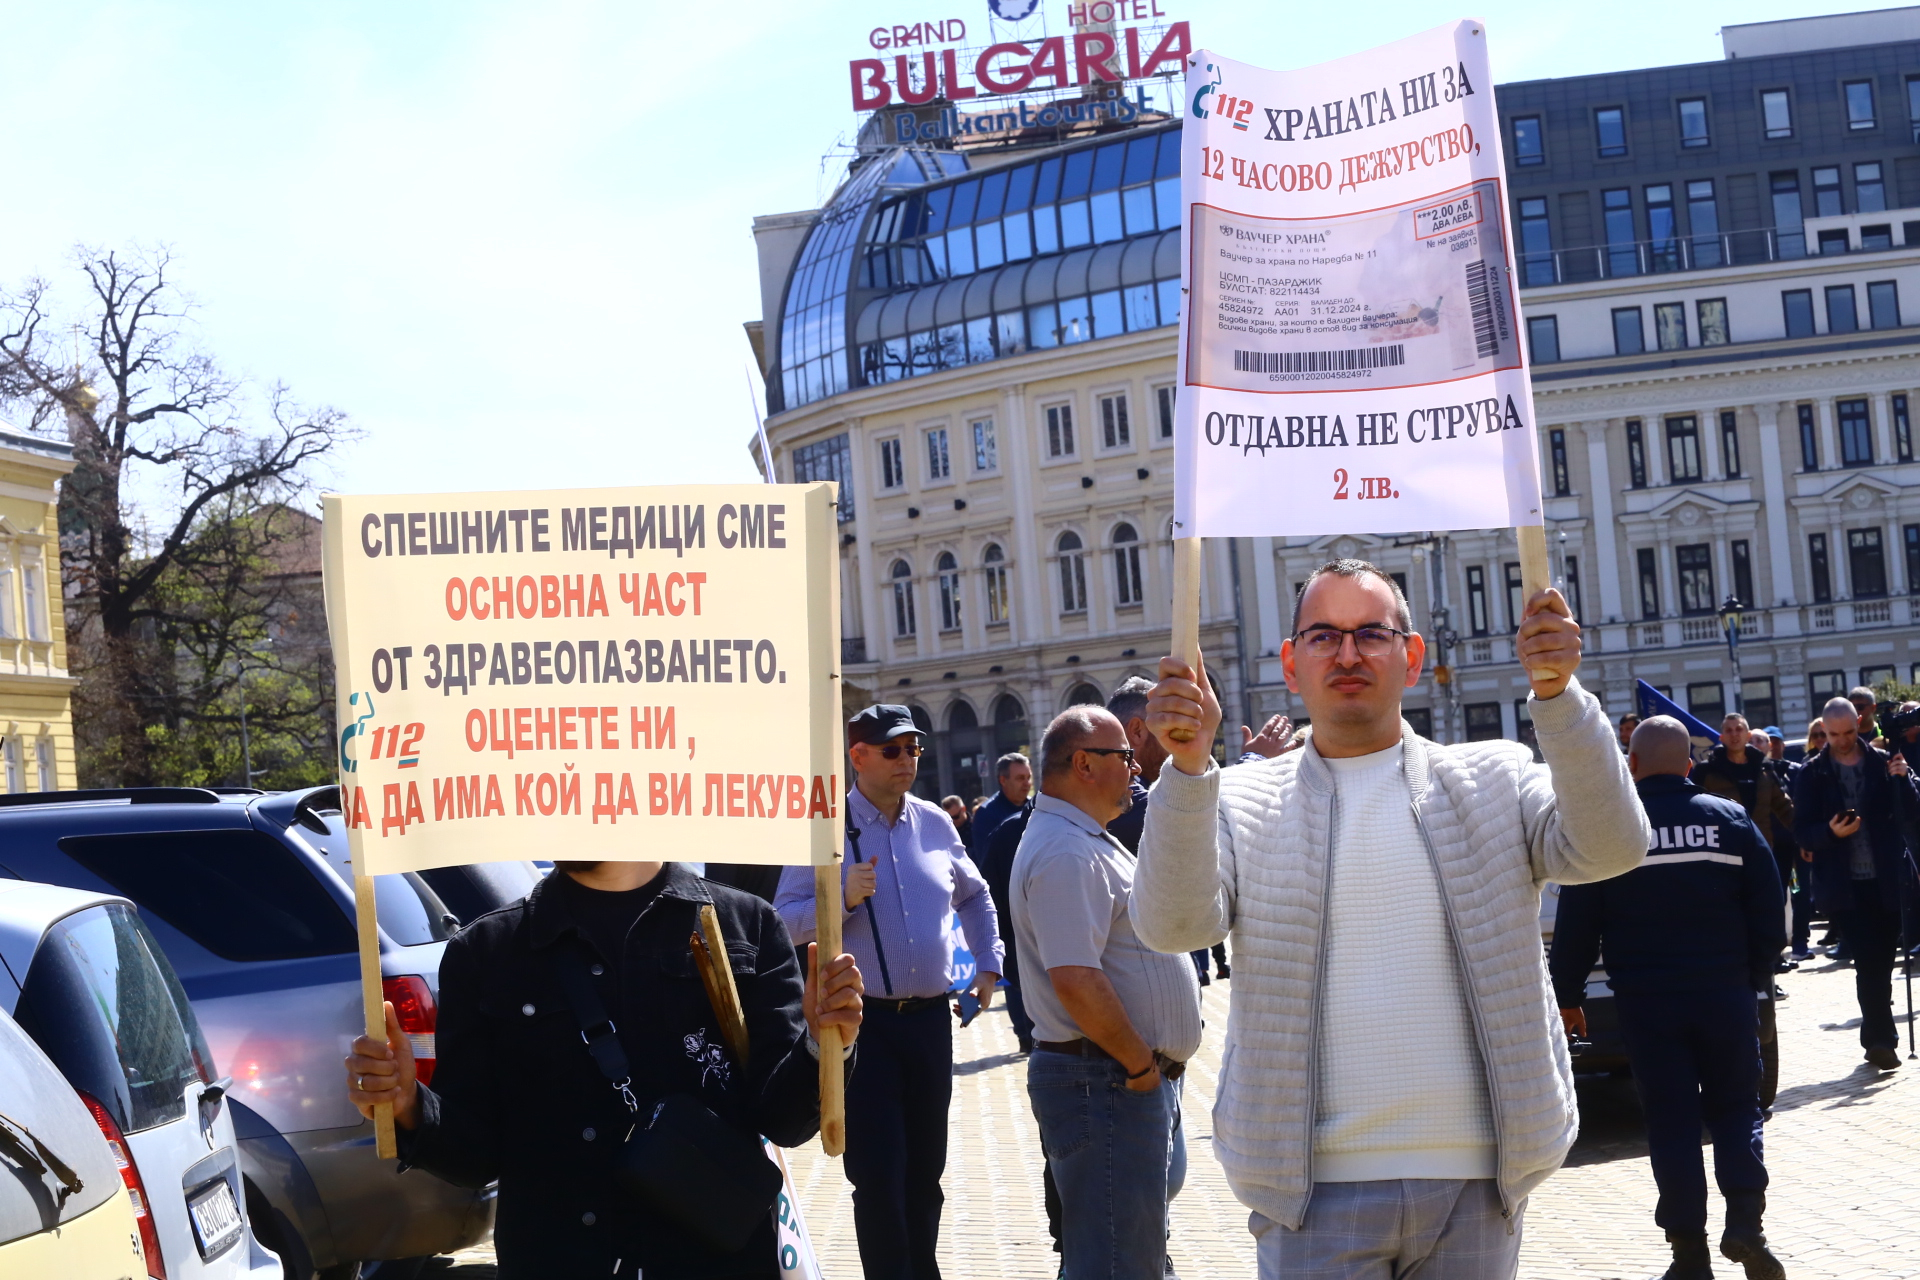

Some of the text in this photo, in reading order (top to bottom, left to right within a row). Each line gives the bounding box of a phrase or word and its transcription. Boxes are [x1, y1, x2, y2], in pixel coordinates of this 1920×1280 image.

[1068, 0, 1165, 27] HOTEL
[869, 19, 966, 50] GRAND
[849, 21, 1192, 111] BULGARIA
[895, 85, 1154, 142] Balkantourist
[1216, 93, 1254, 124] 112
[1264, 61, 1474, 141] ХРАНАТА НИ ЗА
[1202, 123, 1481, 194] 12 ЧАСОВО ДЕЖУРСТВО,
[1432, 211, 1474, 233] ДВА ЛЕВА
[1236, 229, 1282, 244] ВАУЧЕР
[1451, 236, 1478, 252] 038913
[1220, 249, 1253, 263] Ваучер
[1255, 257, 1266, 265] за
[1268, 258, 1296, 266] храна
[1312, 253, 1352, 265] Наредба
[1367, 250, 1377, 258] 11
[1219, 271, 1249, 284] ЦСМП
[1257, 277, 1323, 287] ПАЗАРДЖИК
[1219, 281, 1320, 296] БУЛСТАТ: 822114434
[1218, 302, 1264, 315] 45824972
[1219, 294, 1246, 304] СЕРИЕН
[1274, 308, 1299, 316] АА01
[1310, 298, 1343, 306] ВАЛИДЕН
[1310, 304, 1361, 315] 31.12.2024
[1218, 313, 1249, 325] Видове
[1250, 318, 1278, 328] храни,
[1326, 315, 1361, 326] валиден
[1362, 311, 1398, 323] ваучера:
[1218, 322, 1247, 333] всички
[1248, 325, 1278, 335] видове
[1279, 327, 1304, 336] храни
[1313, 325, 1340, 334] готов
[1343, 322, 1357, 333] вид
[1358, 322, 1369, 330] за
[1369, 316, 1419, 329] консумация
[1205, 394, 1524, 457] ОТДАВНА НЕ СТРУВА
[1333, 468, 1348, 500] 2
[361, 503, 787, 559] СПЕШНИТЕ МЕДИЦИ СМЕ
[445, 571, 707, 621] ОСНОВНА ЧАСТ
[372, 639, 787, 697] ОТ ЗДРАВЕОПАЗВАНЕТО.
[370, 722, 425, 760] 112
[465, 706, 620, 760] ОЦЕНЕТЕ
[381, 781, 425, 838] ДА
[433, 774, 506, 823] ИМА
[515, 762, 582, 818] КОЙ
[592, 773, 639, 825] ДА
[649, 773, 692, 817] ВИ
[702, 773, 837, 820] ЛЕКУВА!
[1648, 825, 1720, 850] LICE
